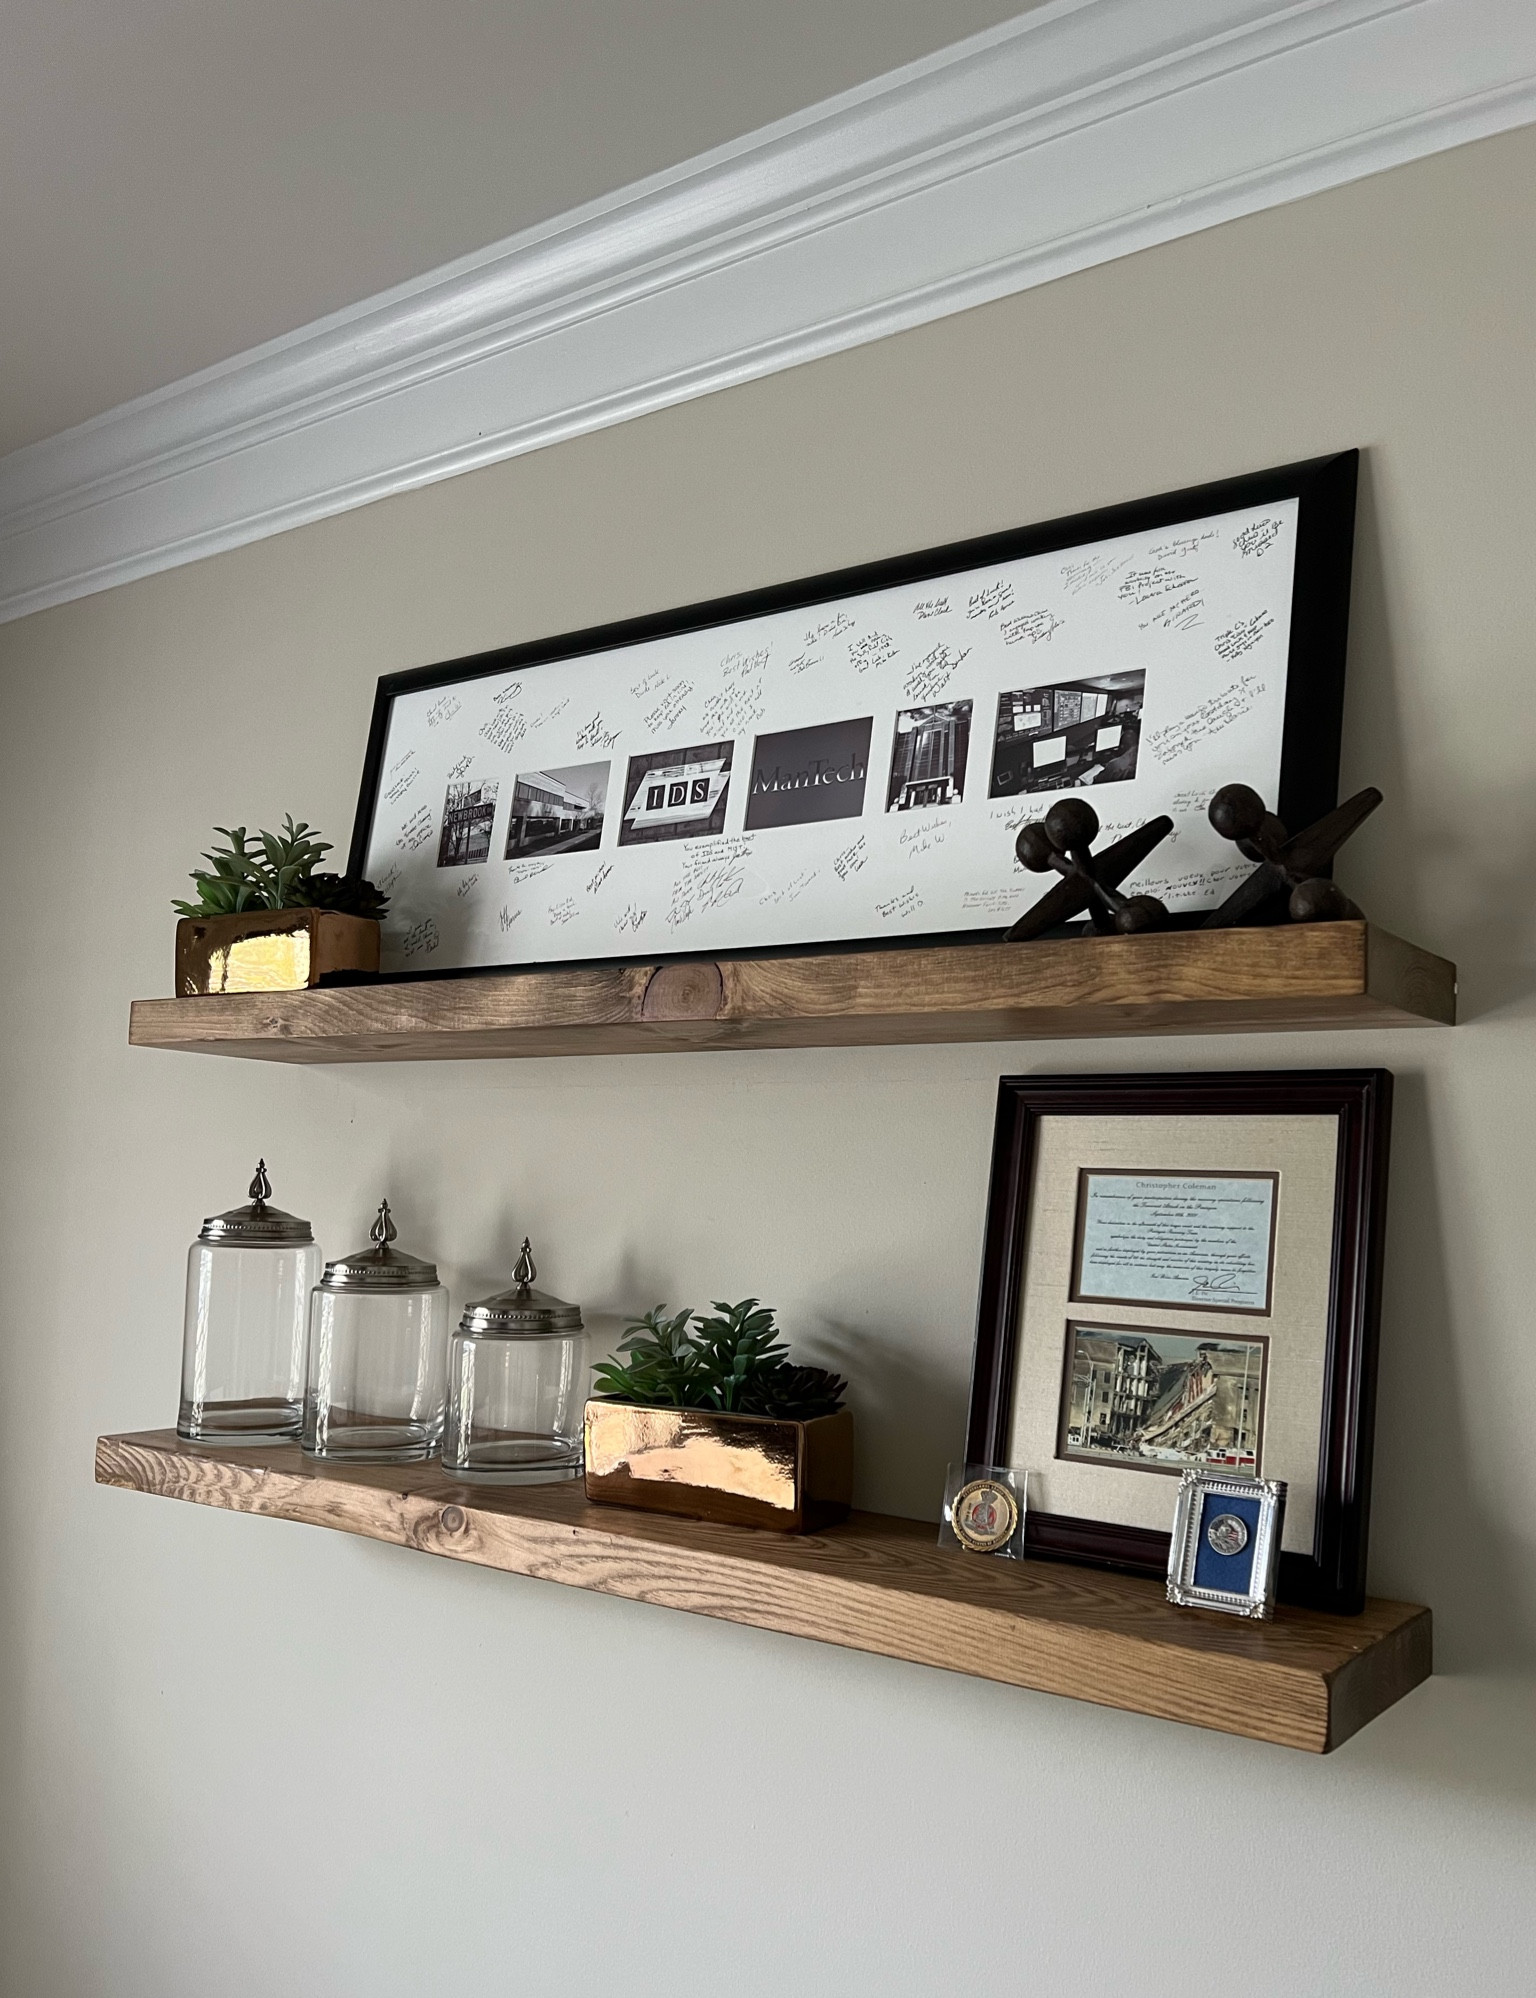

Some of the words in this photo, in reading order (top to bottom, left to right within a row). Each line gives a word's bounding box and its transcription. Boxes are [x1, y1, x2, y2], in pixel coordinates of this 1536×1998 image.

[751, 752, 866, 796] ManTech
[651, 780, 707, 808] IDS
[448, 805, 488, 824] NEWBROOK
[996, 805, 1016, 819] wish
[900, 828, 921, 845] Best
[934, 833, 946, 843] W
[1136, 1181, 1180, 1191] Christopher
[1183, 1182, 1217, 1190] Coleman
